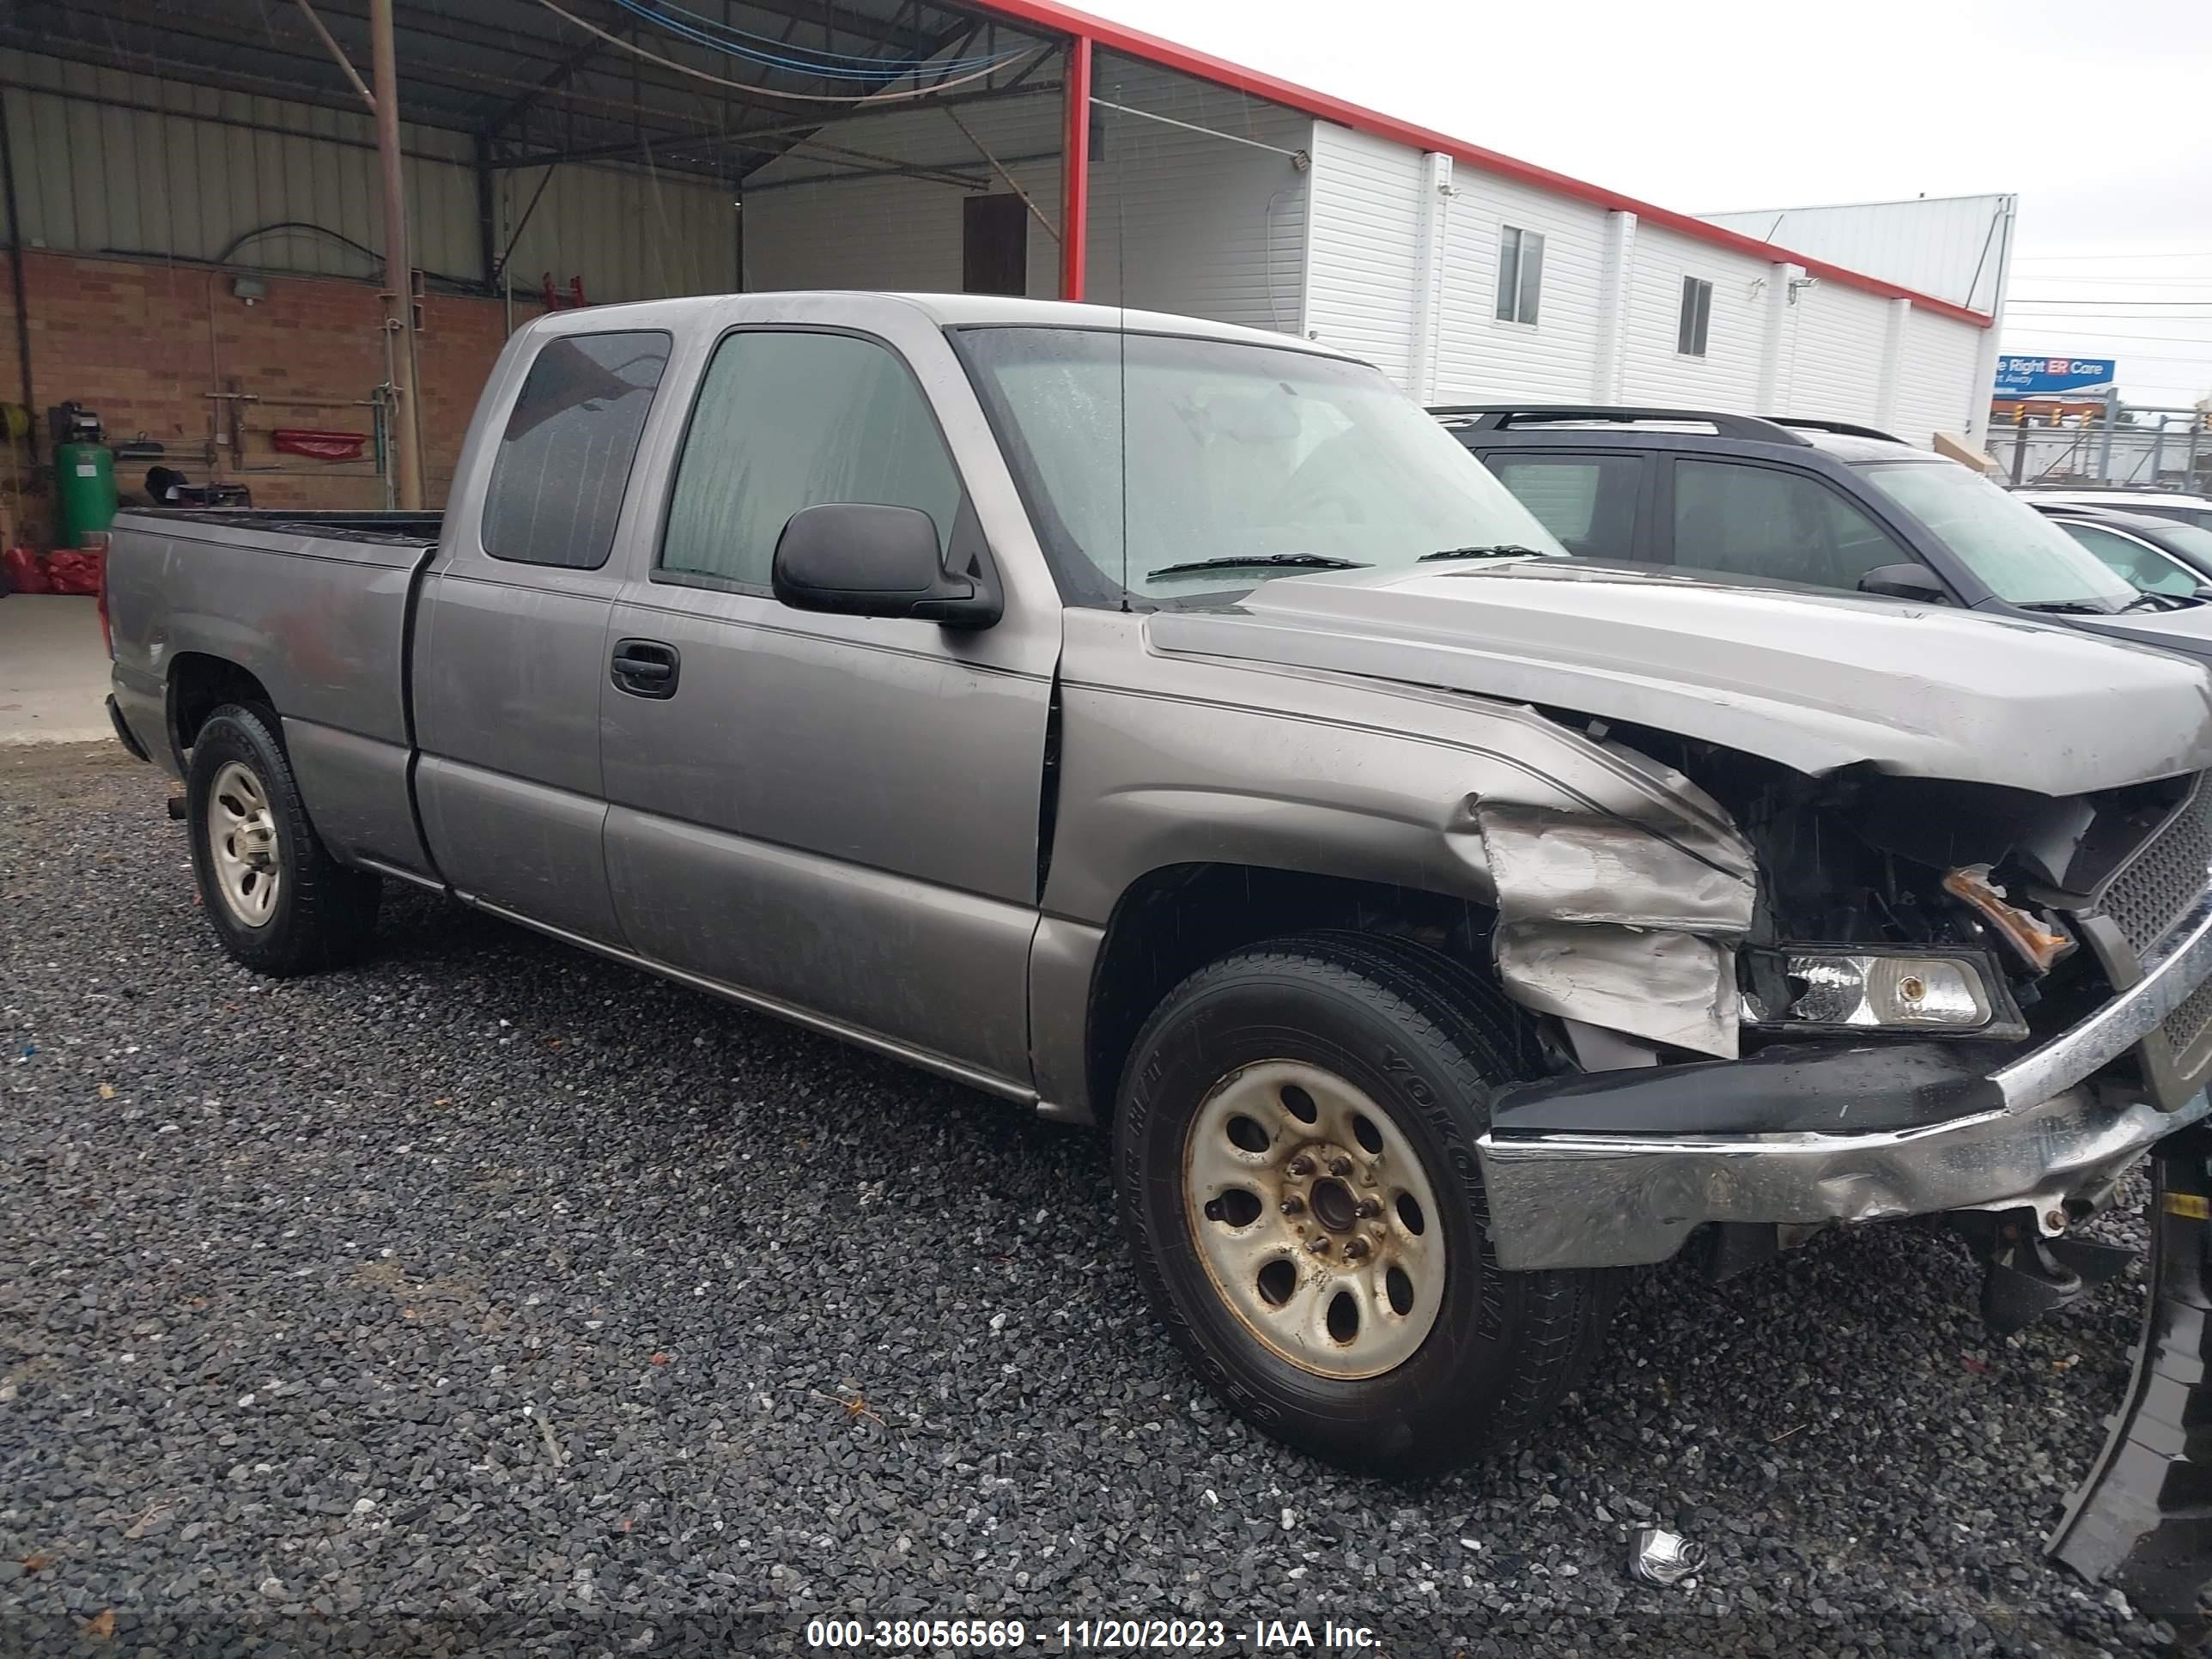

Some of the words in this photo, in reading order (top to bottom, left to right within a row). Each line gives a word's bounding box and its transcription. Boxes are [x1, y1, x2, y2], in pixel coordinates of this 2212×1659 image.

[2009, 358, 2045, 375] Right
[2048, 359, 2069, 374] ER
[2070, 361, 2104, 374] Care
[2005, 374, 2033, 386] Away
